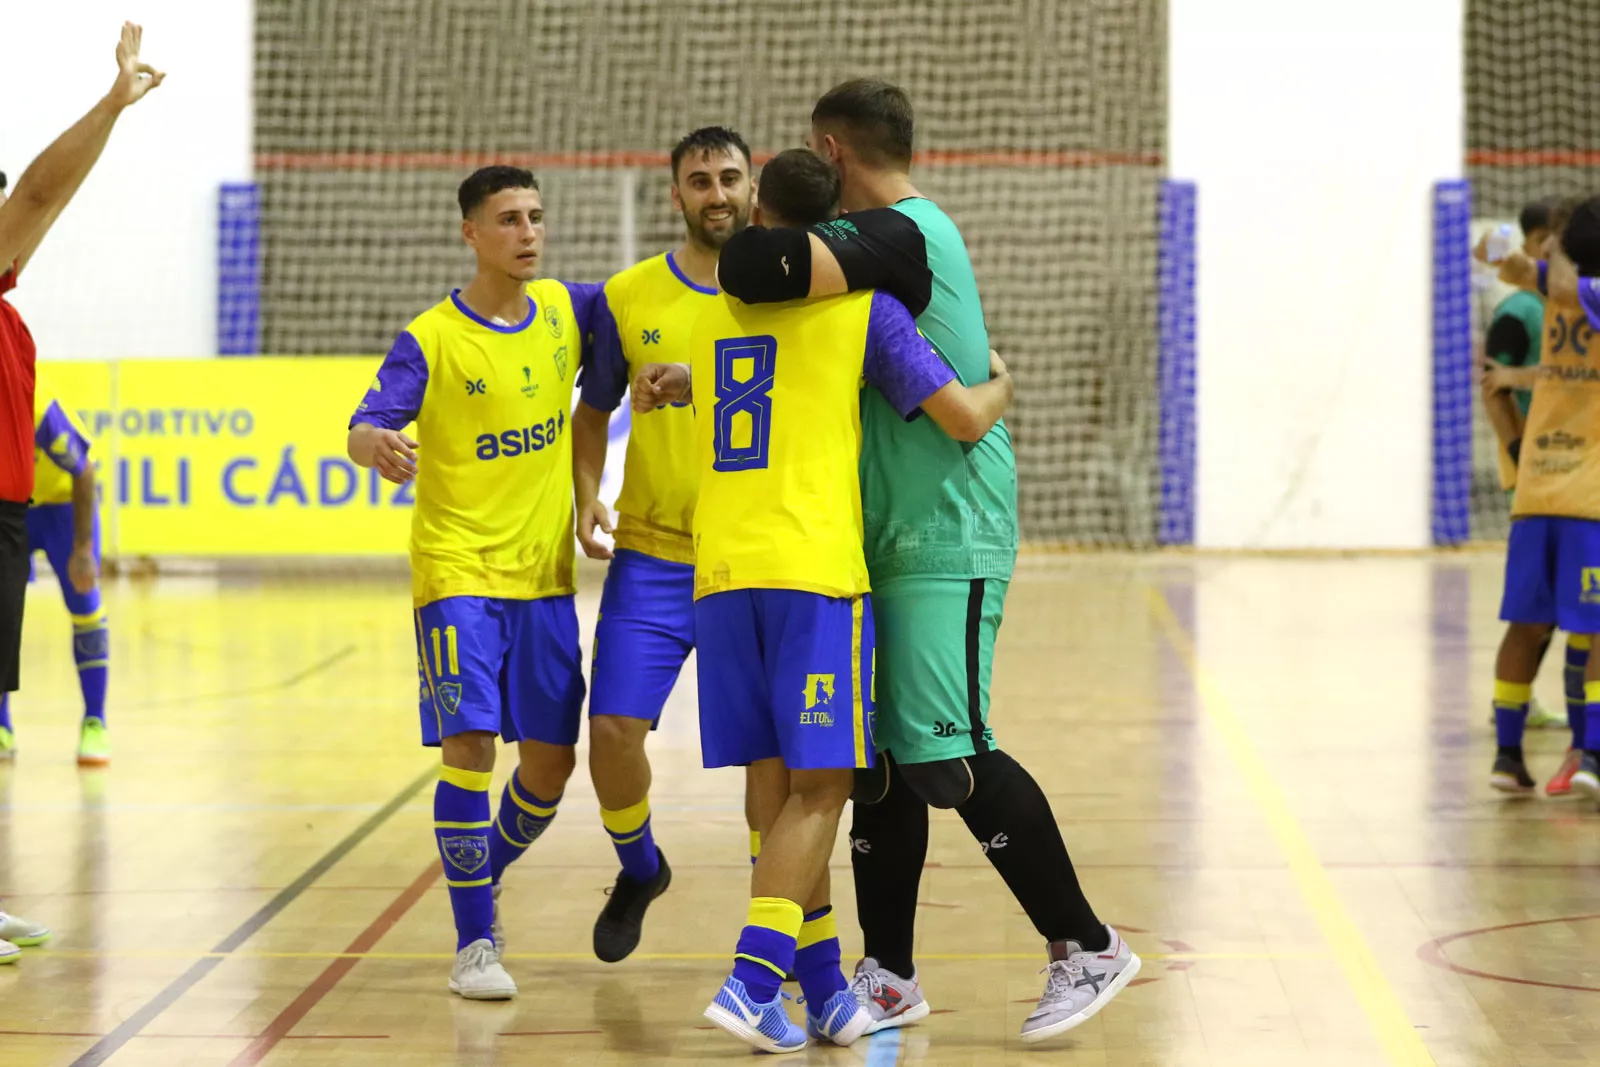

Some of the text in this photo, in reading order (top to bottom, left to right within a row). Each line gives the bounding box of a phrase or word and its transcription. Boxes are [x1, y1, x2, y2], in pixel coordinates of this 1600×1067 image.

[713, 335, 777, 472] 8
[95, 456, 191, 506] ILI
[430, 625, 460, 677] 11
